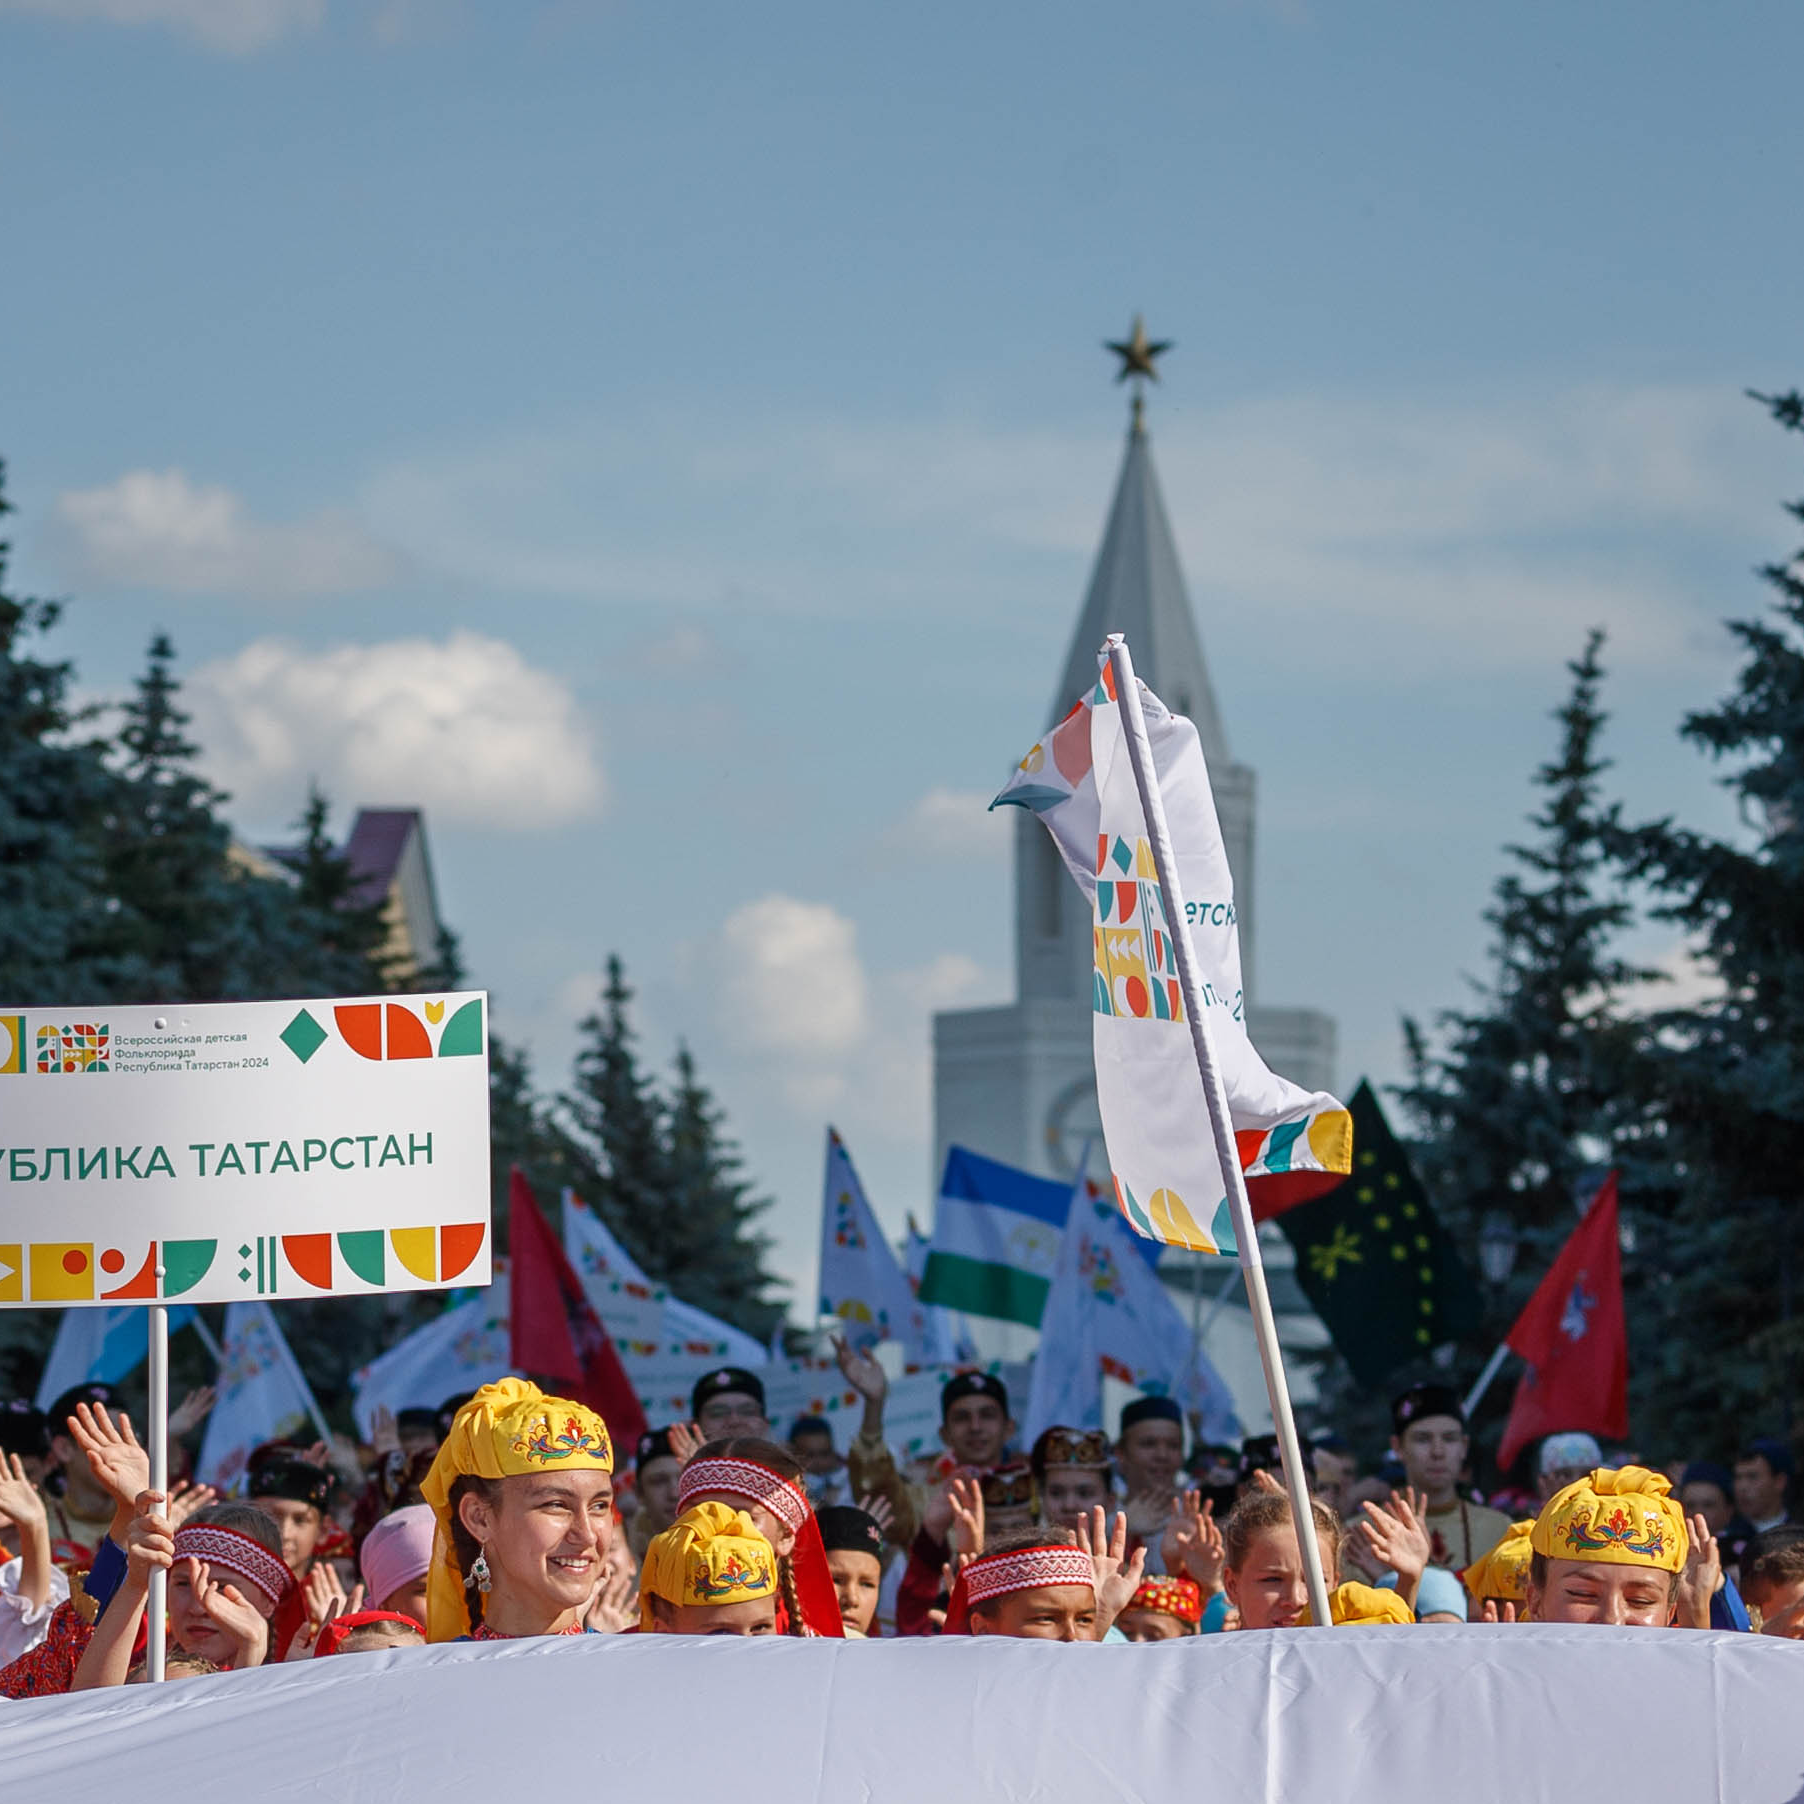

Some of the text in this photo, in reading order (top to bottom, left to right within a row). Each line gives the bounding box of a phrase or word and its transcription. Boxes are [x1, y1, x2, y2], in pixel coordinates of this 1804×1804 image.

[114, 1033, 248, 1047] Всероссийская детская
[114, 1048, 196, 1059] Фольклориада
[114, 1057, 269, 1073] Республика Татарстан 2024
[189, 1131, 434, 1177] ТАТАРСТАН
